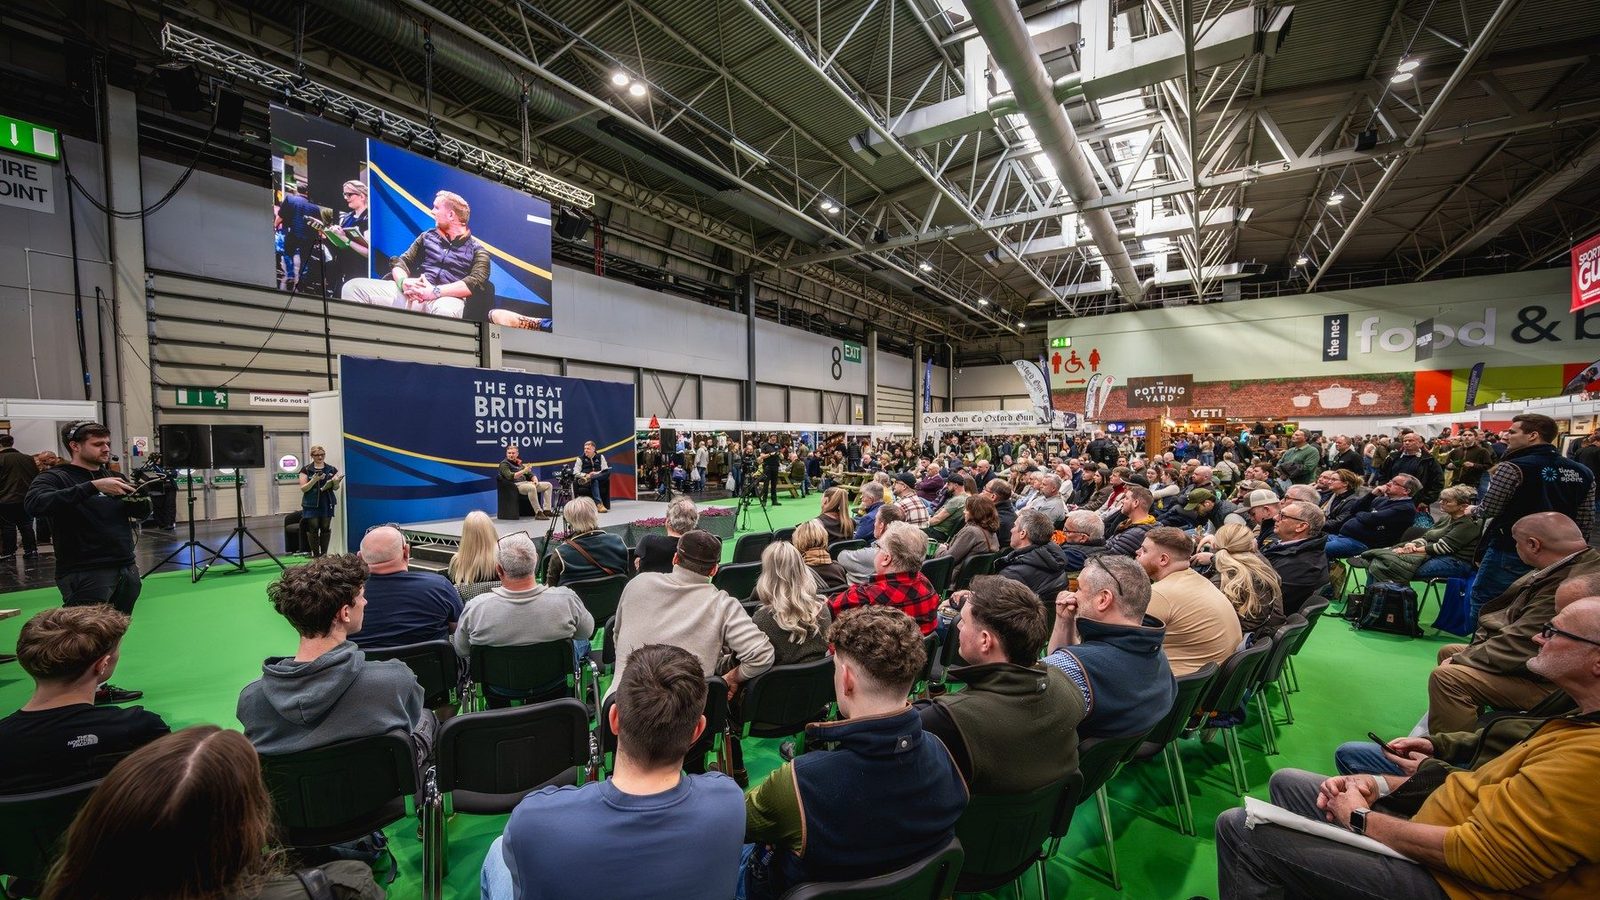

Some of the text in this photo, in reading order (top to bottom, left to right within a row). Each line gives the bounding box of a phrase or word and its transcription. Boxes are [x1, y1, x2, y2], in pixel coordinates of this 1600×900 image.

[0, 159, 38, 181] IRE
[1283, 162, 1290, 171] 5
[1511, 305, 1562, 344] &
[491, 332, 500, 340] 8.1
[1327, 319, 1340, 357] the nec
[845, 344, 861, 359] EXIT
[832, 346, 842, 380] 8
[1016, 360, 1035, 380] Oxford
[1033, 379, 1044, 394] Gun
[1041, 394, 1049, 403] Co
[474, 381, 562, 398] THE GREAT
[1134, 386, 1185, 397] POTTING
[1146, 394, 1174, 403] YARD
[474, 395, 563, 420] BRITISH
[1191, 409, 1223, 418] YETI
[923, 414, 982, 424] Oxford Gun Co
[984, 413, 1034, 422] Oxford Gun
[475, 419, 564, 434] SHOOTING
[500, 436, 543, 447] SHOW
